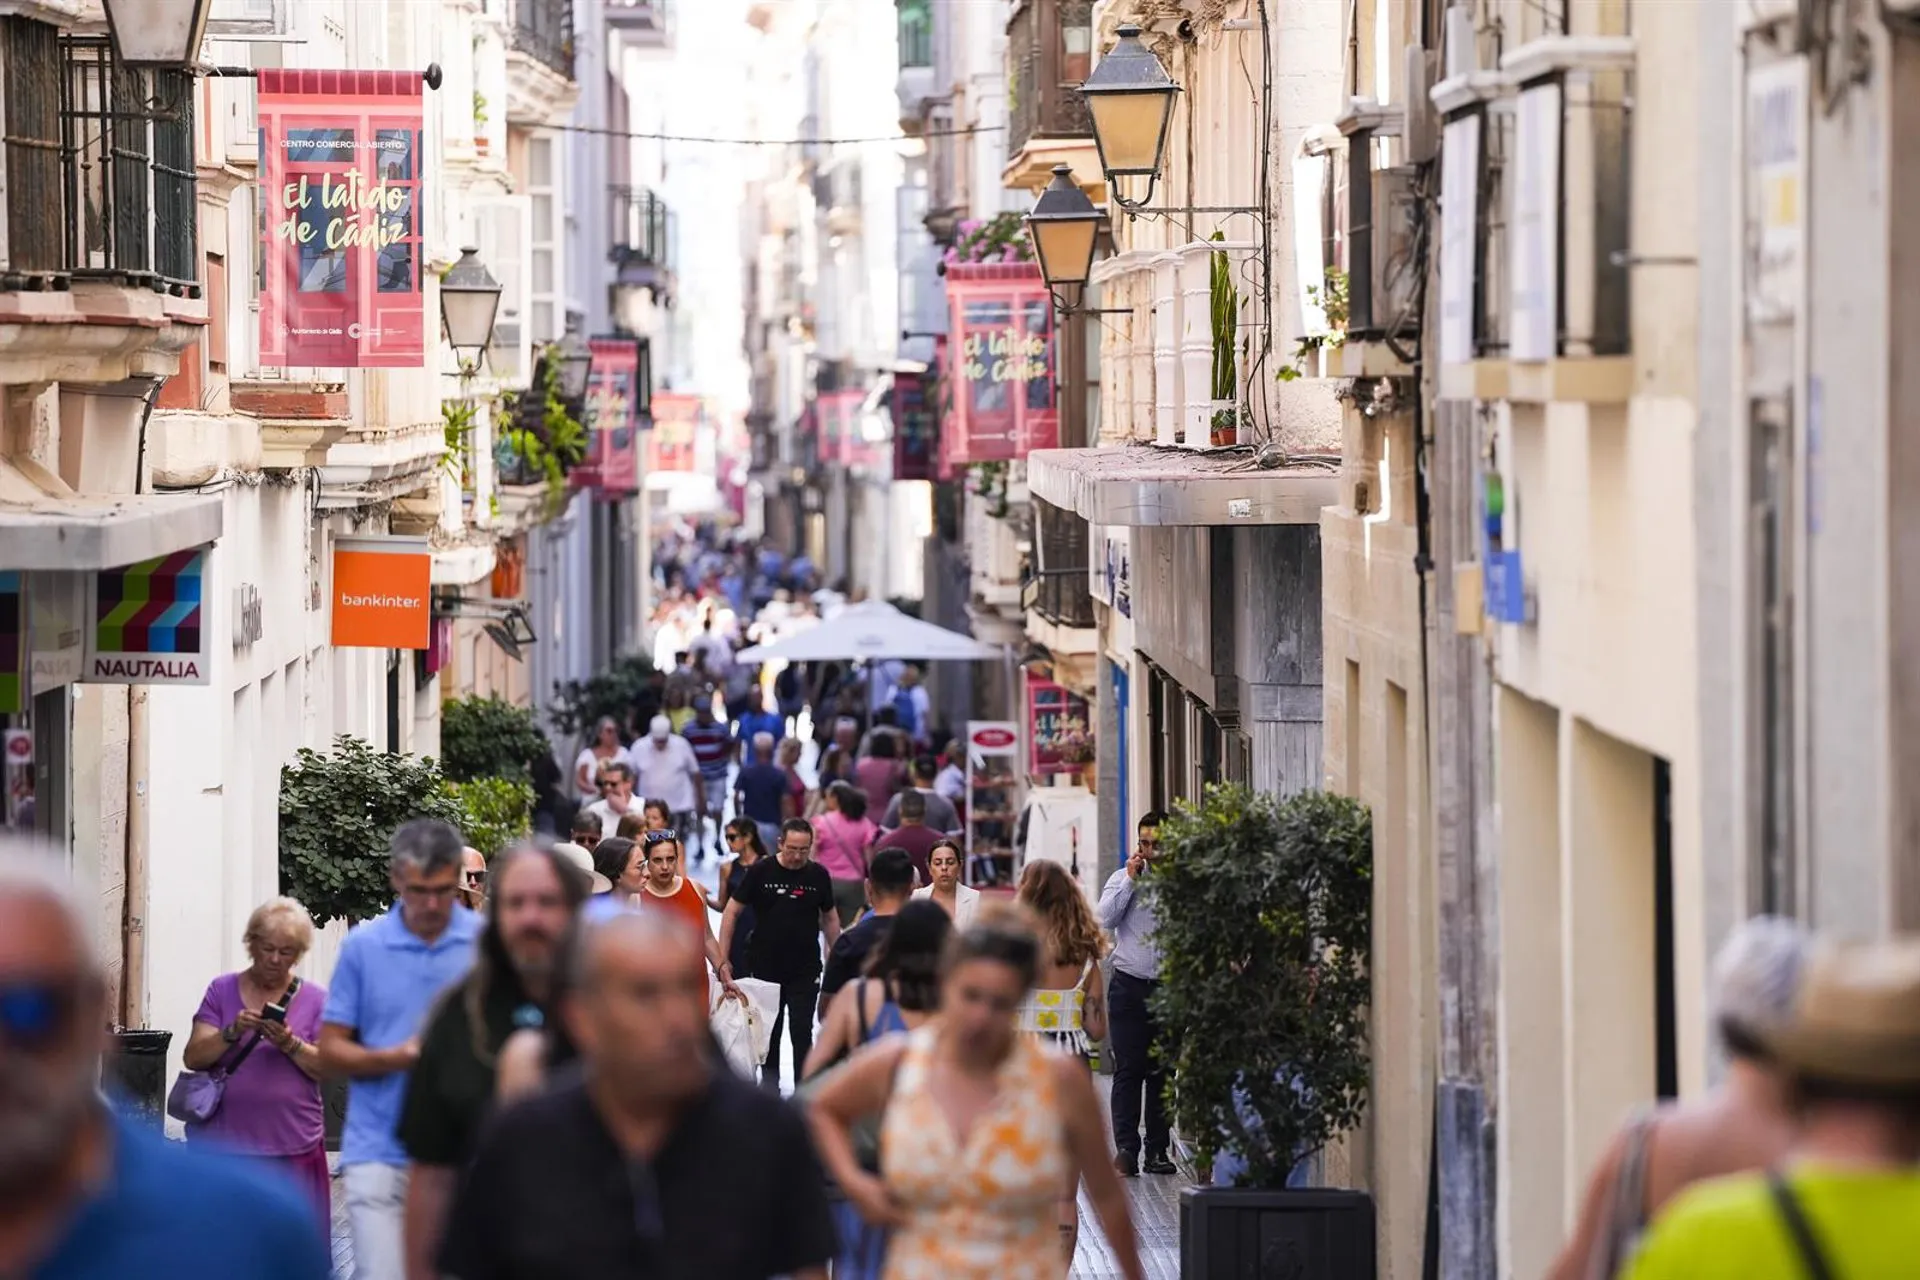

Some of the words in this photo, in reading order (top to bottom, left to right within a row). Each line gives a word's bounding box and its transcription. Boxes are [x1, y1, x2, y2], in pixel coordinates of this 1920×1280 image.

[280, 140, 315, 149] CENTRO
[316, 140, 365, 149] COMERCIAL
[366, 141, 402, 149] ABIERTO
[283, 174, 312, 209] El
[322, 167, 408, 214] latido
[277, 212, 318, 246] de
[326, 213, 409, 252] Cádiz
[94, 659, 200, 678] NAUTALIA
